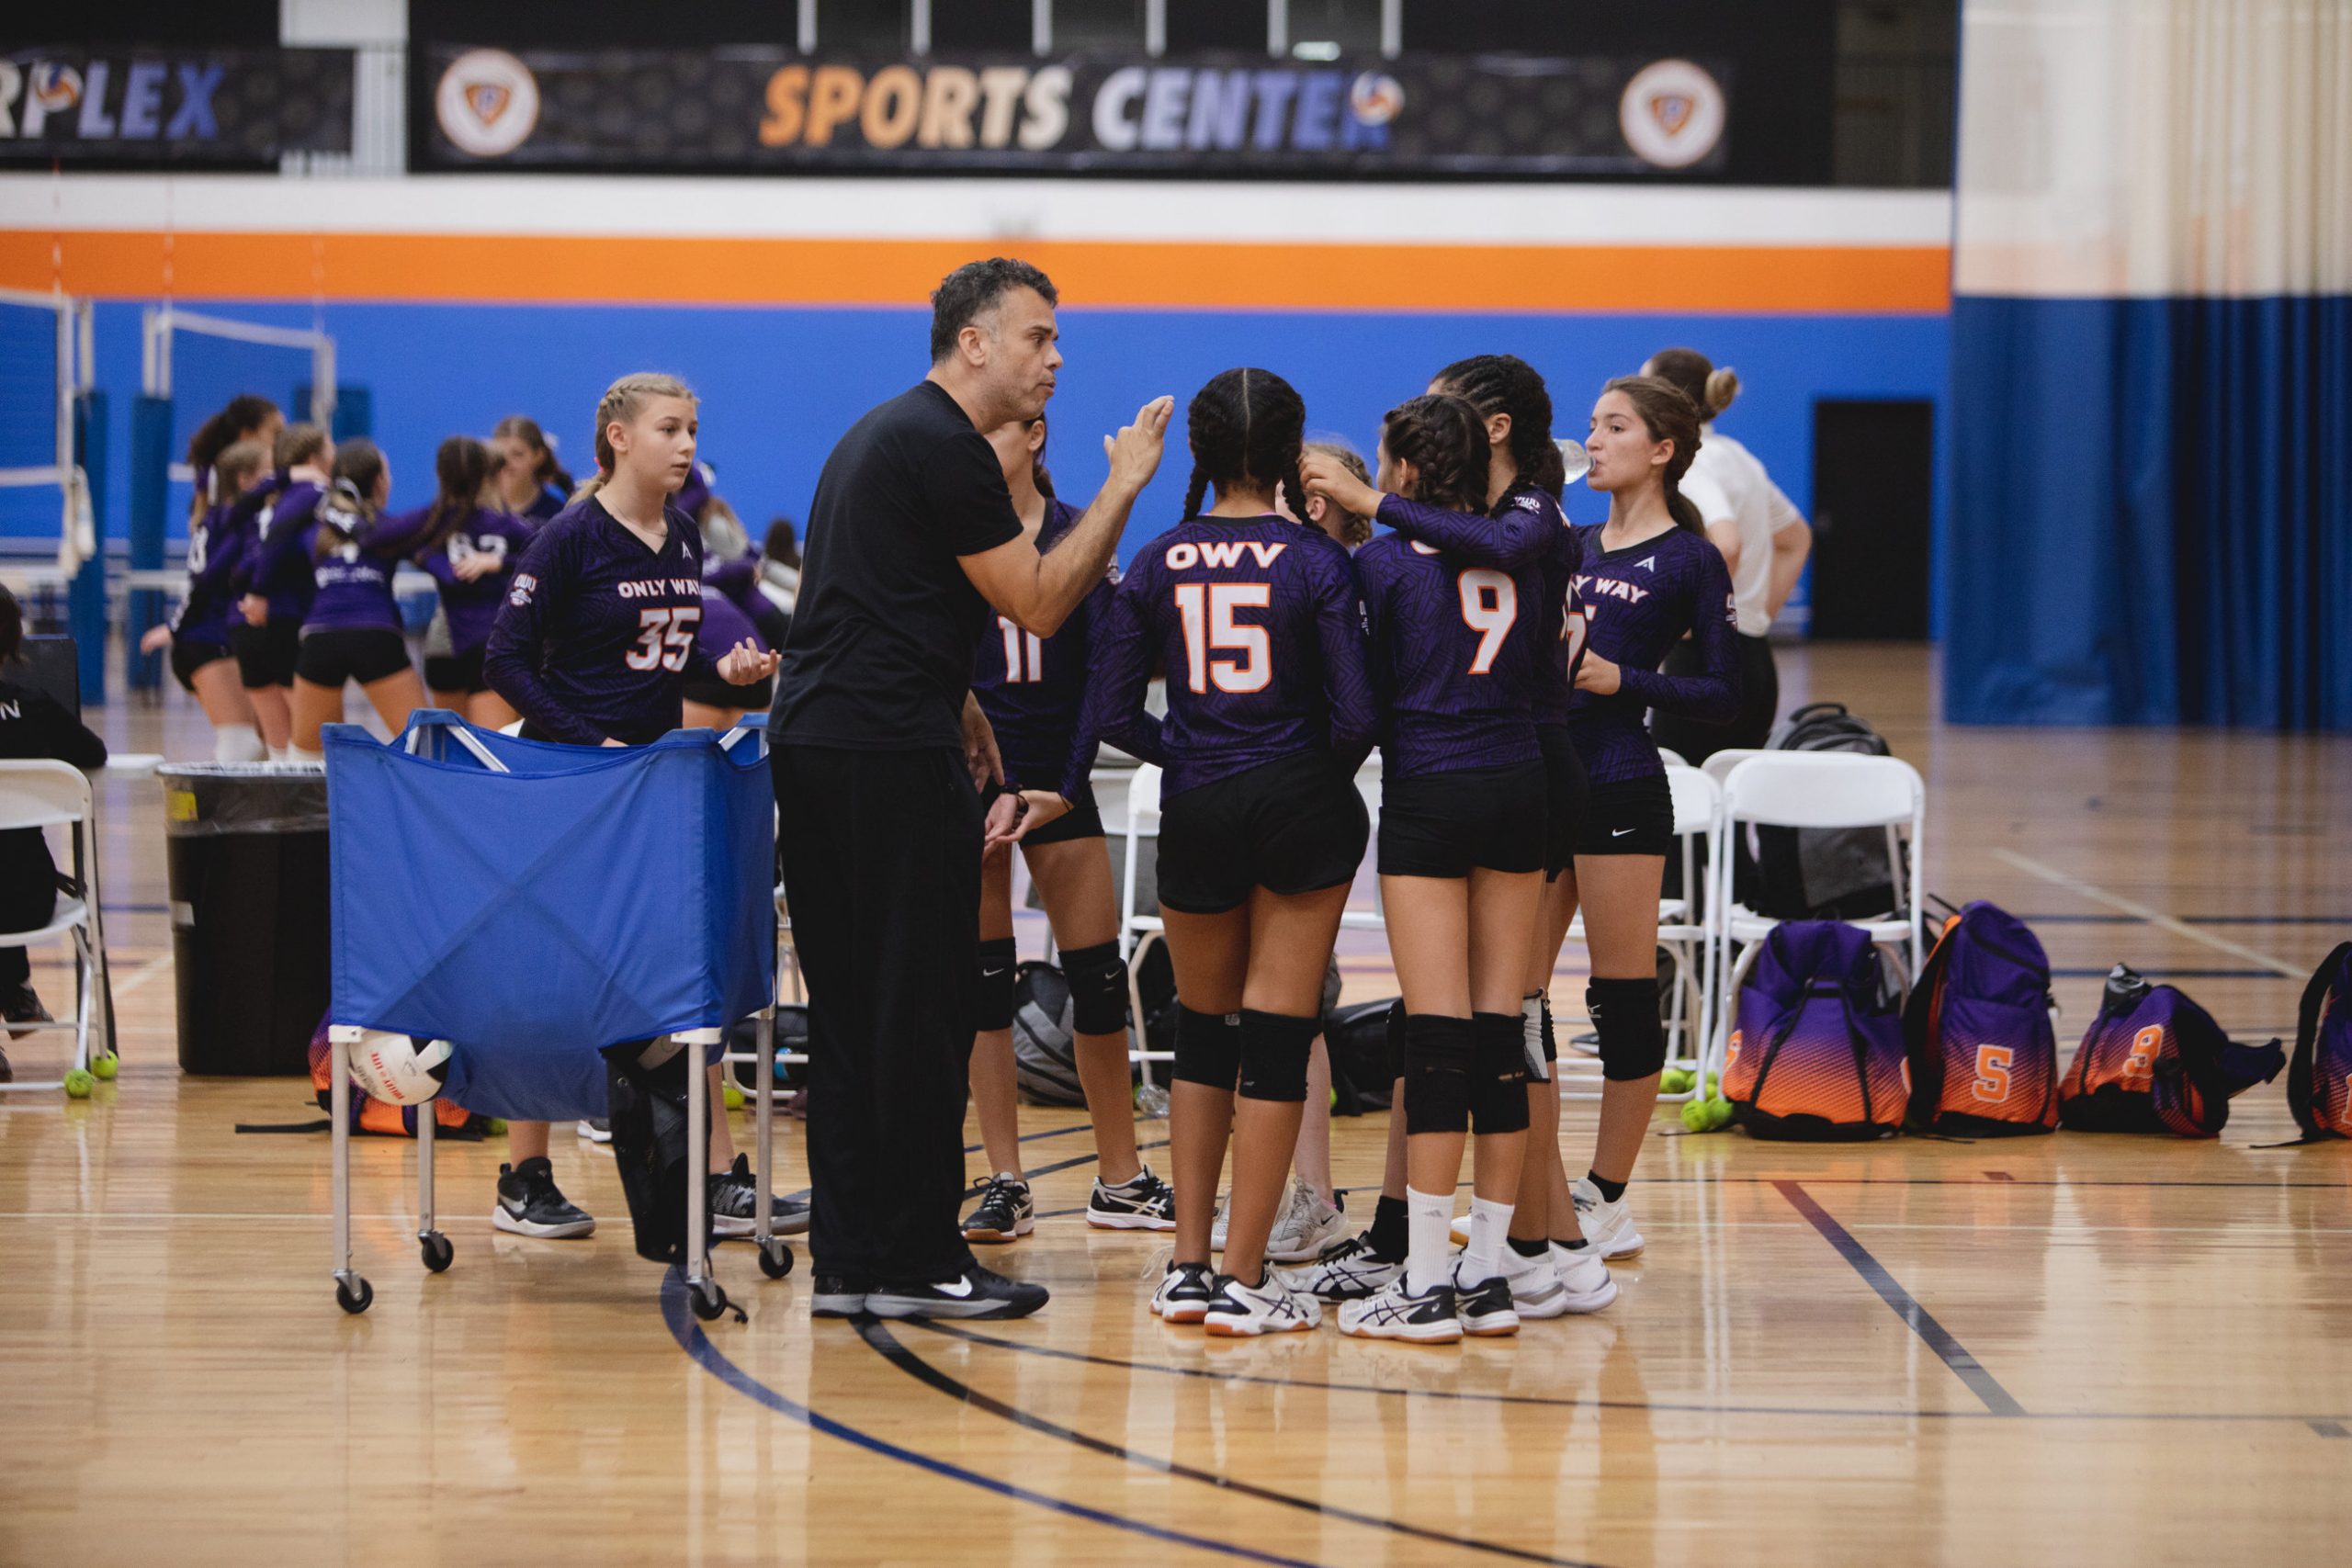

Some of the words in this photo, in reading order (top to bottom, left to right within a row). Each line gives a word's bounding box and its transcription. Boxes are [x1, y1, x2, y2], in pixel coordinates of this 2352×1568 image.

[758, 63, 1074, 151] SPORTS
[1166, 541, 1288, 570] OWV
[617, 578, 666, 599] ONLY
[1594, 577, 1651, 604] WAY
[626, 607, 701, 672] 35
[1175, 582, 1272, 694] 15
[1457, 566, 1518, 675] 9
[1972, 1043, 2013, 1103] 5
[2122, 1024, 2163, 1079] 9
